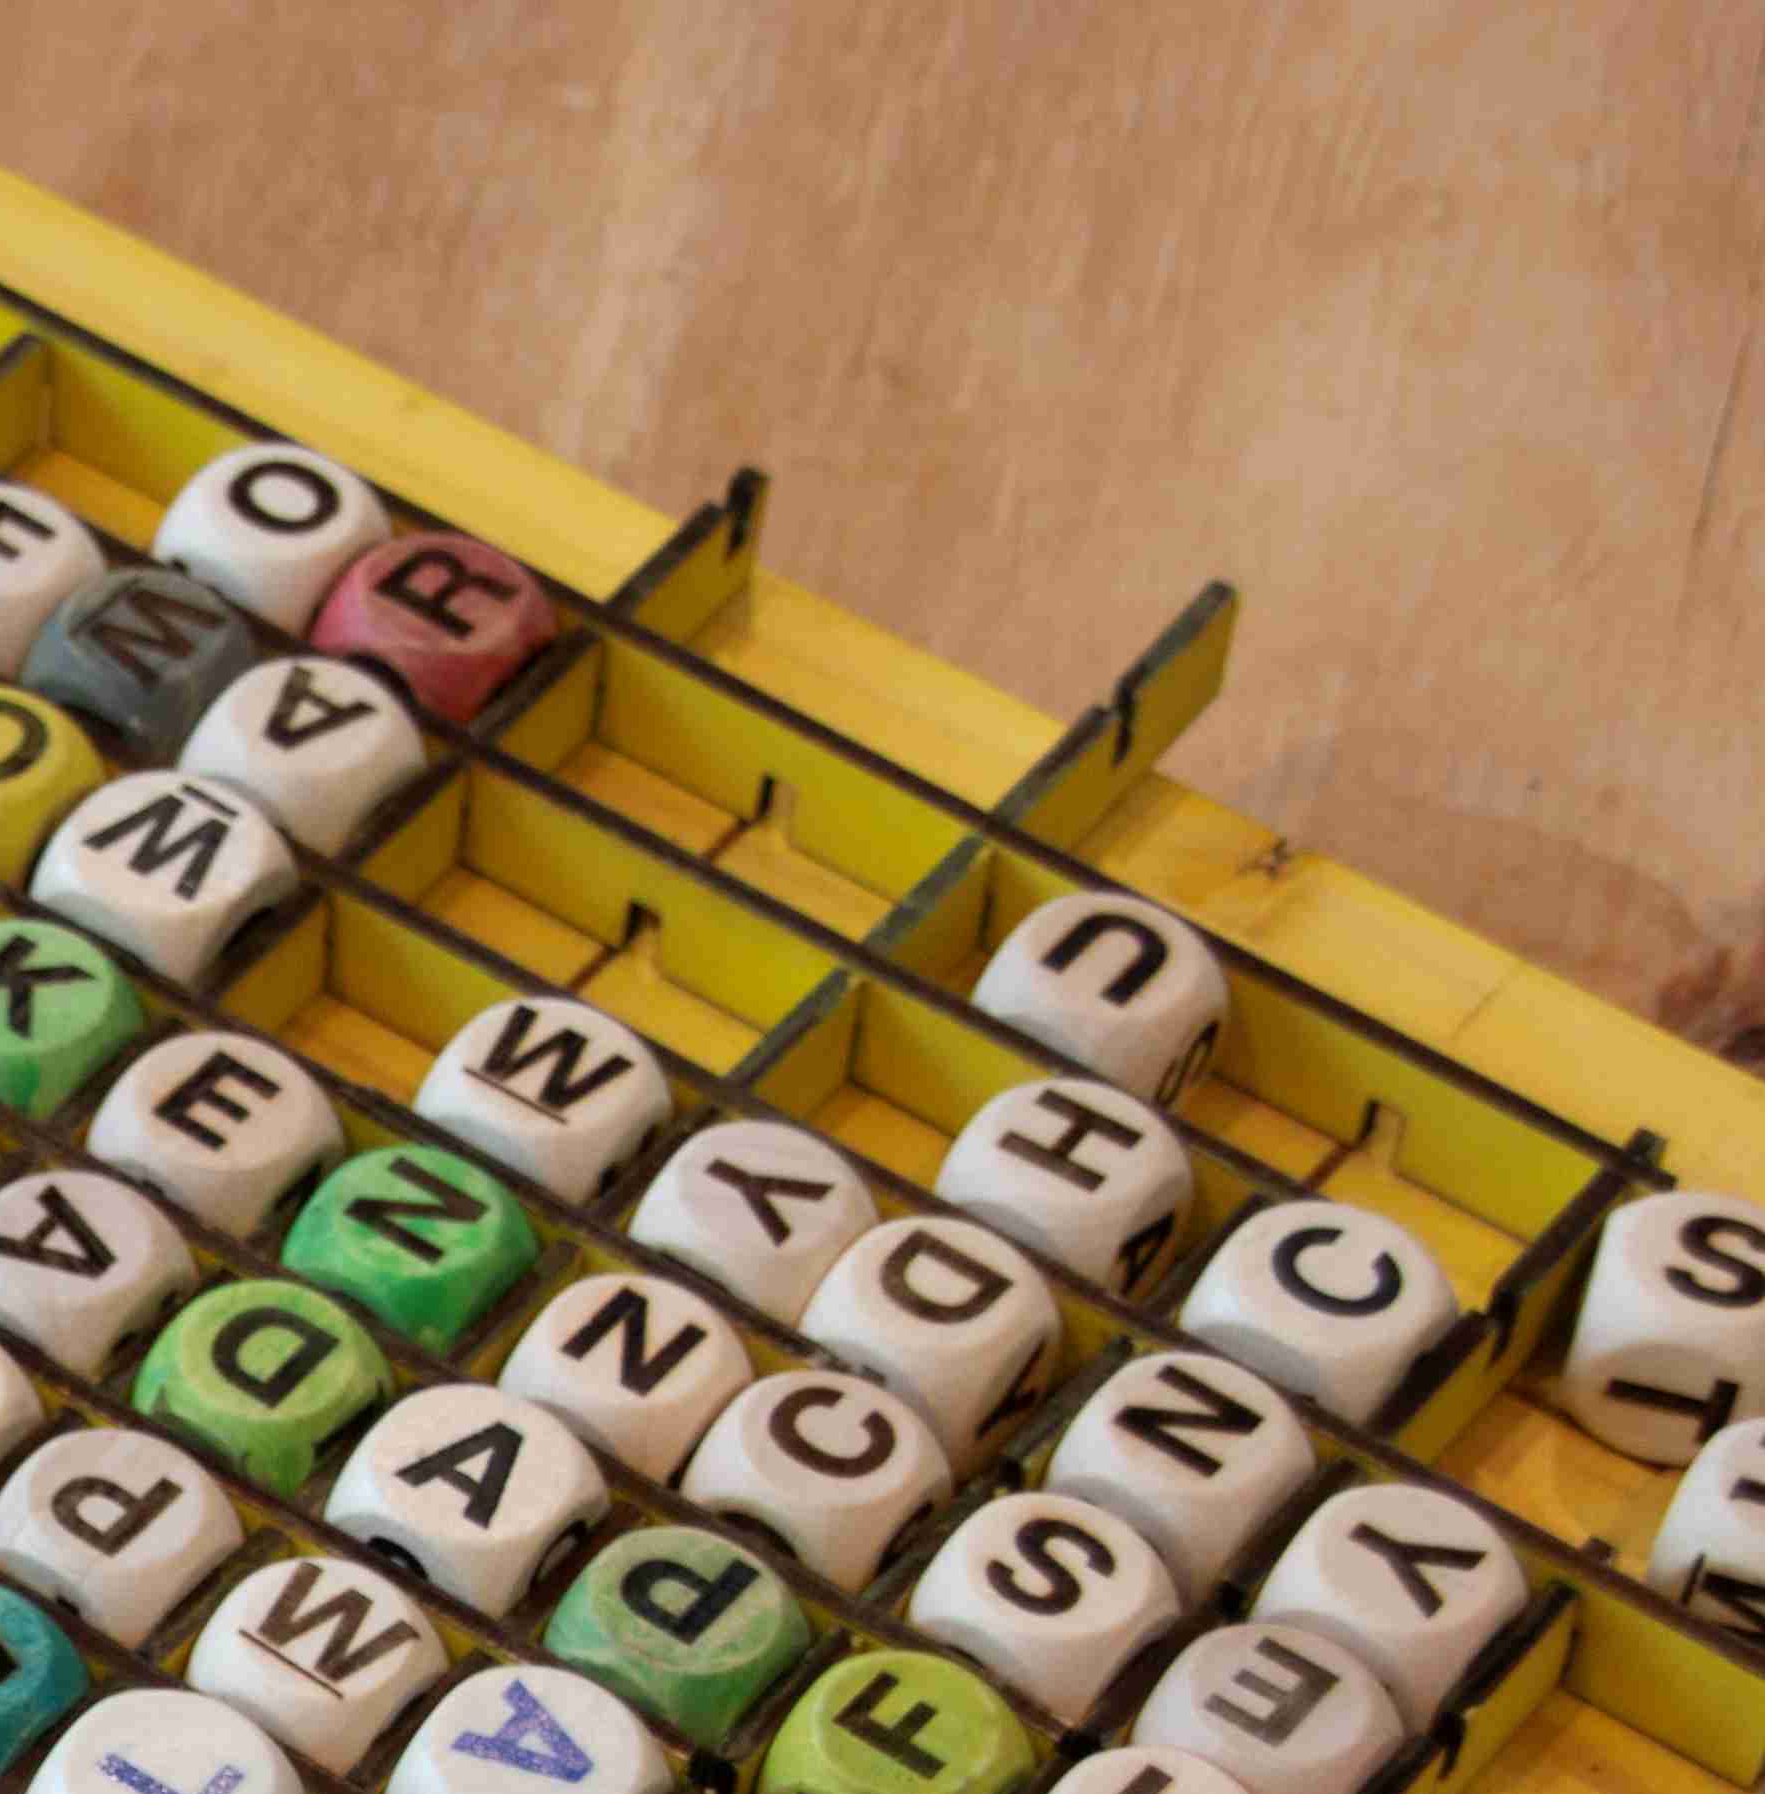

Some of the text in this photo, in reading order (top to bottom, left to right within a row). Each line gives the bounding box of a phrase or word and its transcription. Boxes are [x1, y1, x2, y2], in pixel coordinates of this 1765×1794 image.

[228, 461, 340, 534] O
[265, 666, 376, 749] A
[1043, 913, 1168, 1005] U
[155, 1052, 280, 1149] E
[1000, 1090, 1143, 1191] H
[707, 1160, 833, 1245] Y
[1273, 1227, 1402, 1316] C
[396, 1422, 523, 1528] A
[770, 1387, 895, 1478] C
[51, 1476, 182, 1556] P
[620, 1559, 759, 1644] P
[987, 1518, 1115, 1614] S
[1352, 1524, 1486, 1617] Y
[834, 1672, 944, 1778] F
